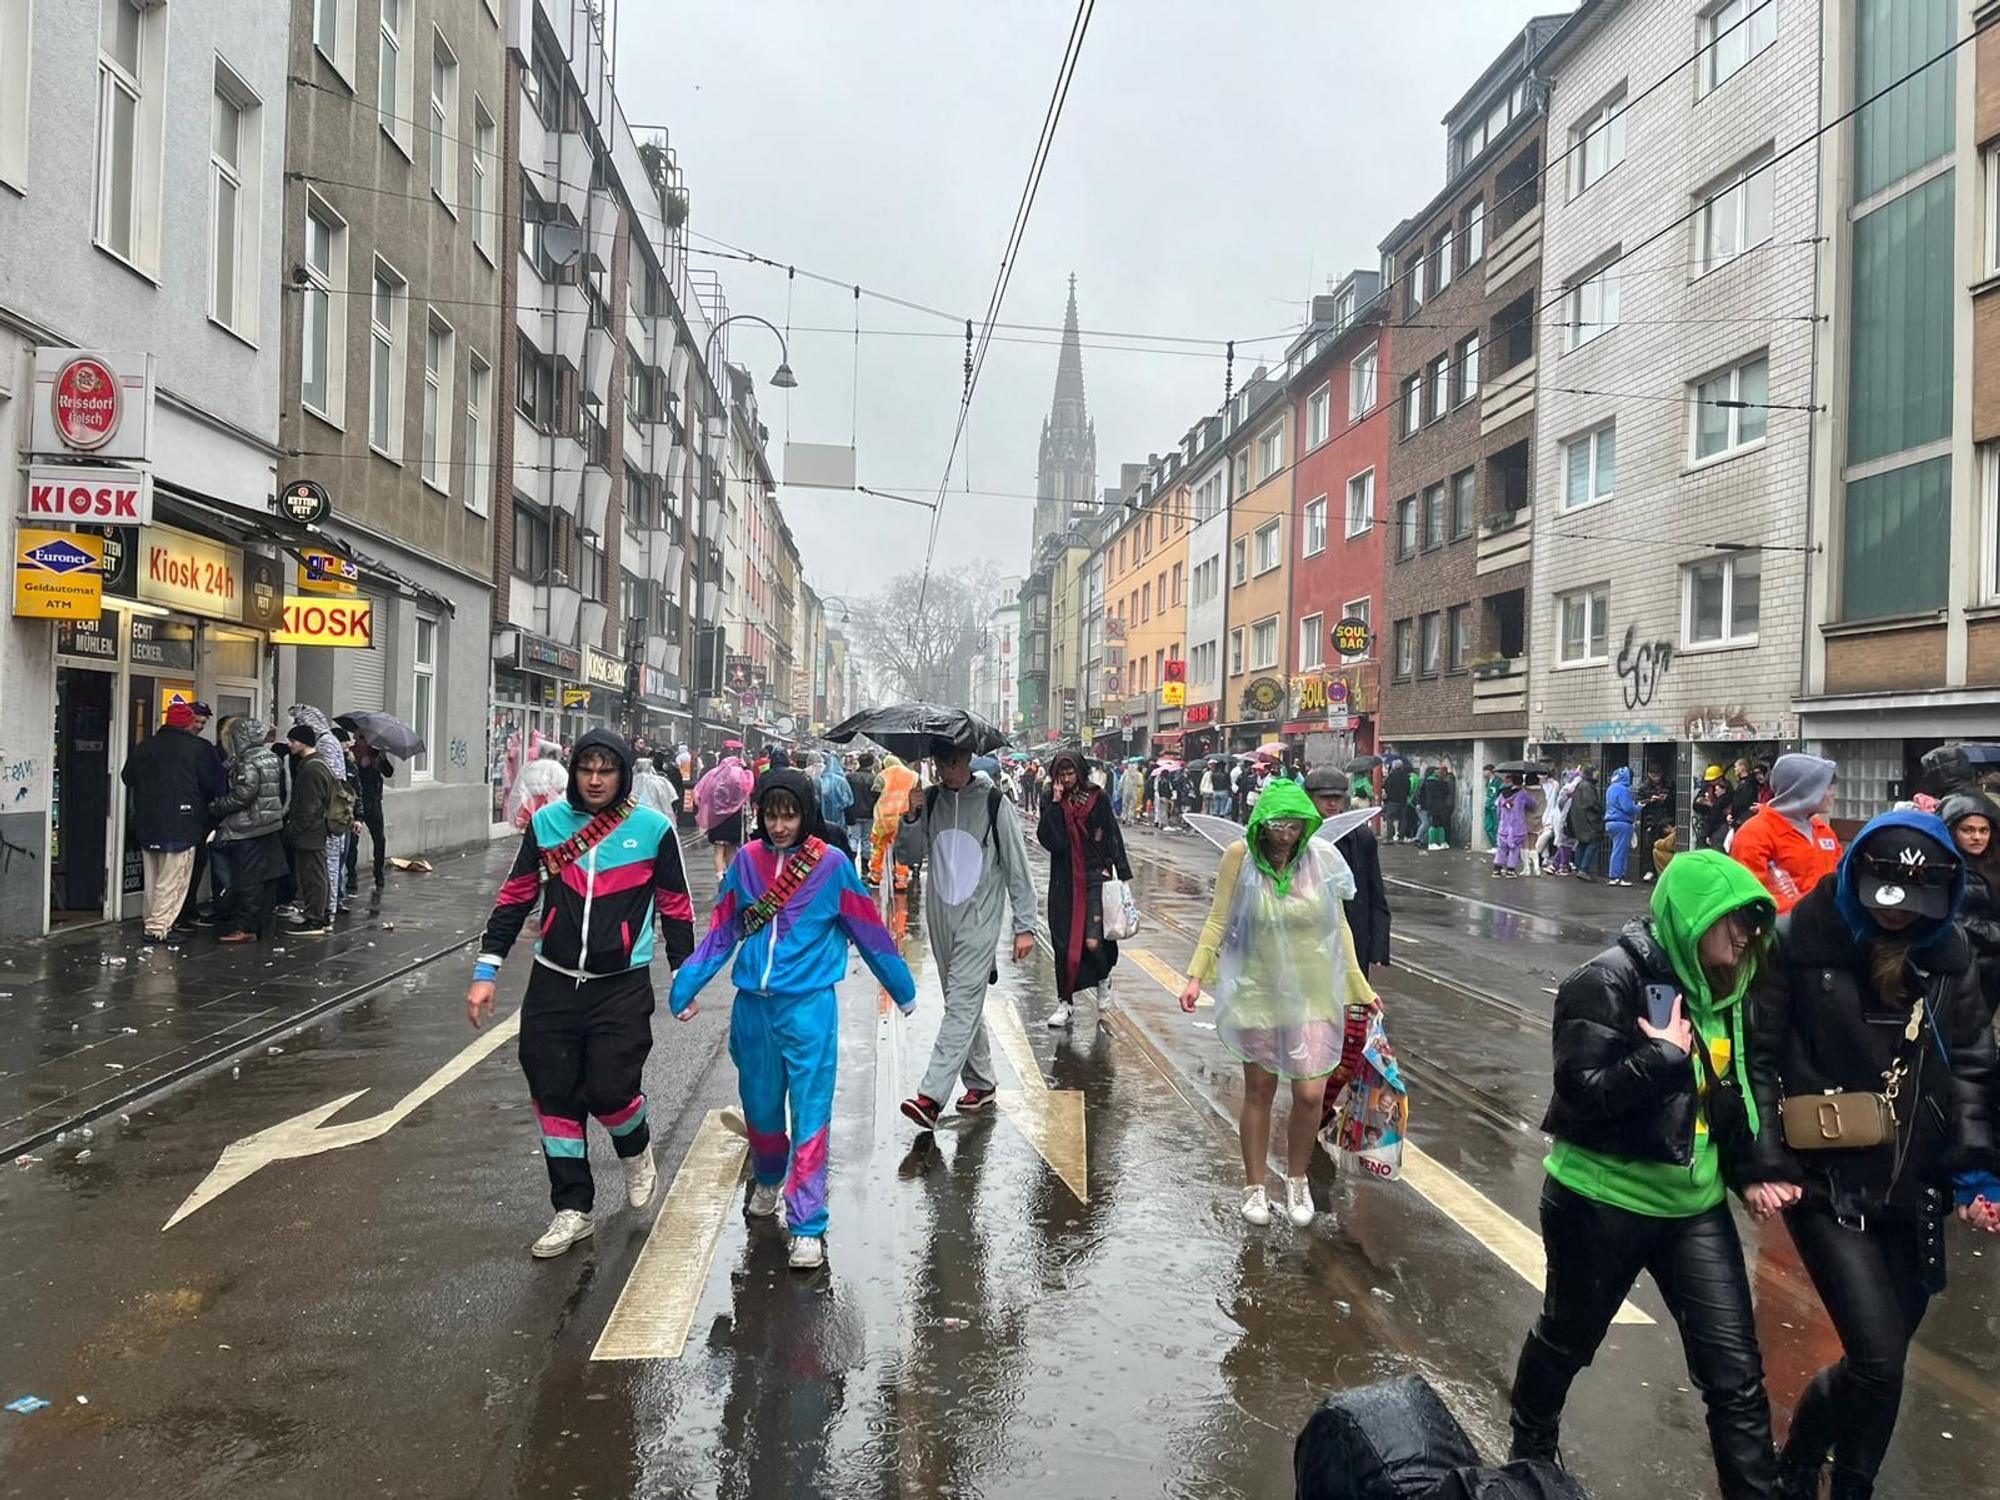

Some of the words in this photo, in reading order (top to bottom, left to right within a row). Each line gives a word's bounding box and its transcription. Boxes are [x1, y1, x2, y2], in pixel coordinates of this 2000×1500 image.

[59, 394, 113, 410] Reissdorf
[31, 485, 138, 517] KIOSK
[287, 496, 318, 508] KETTEN
[292, 507, 312, 516] FETT
[35, 549, 87, 565] Euronet
[103, 555, 117, 572] ETT
[149, 546, 200, 591] Kiosk
[205, 562, 234, 600] 24h
[24, 582, 95, 596] Geldautomat
[46, 600, 72, 609] ATM
[132, 621, 153, 640] ECHT
[1336, 626, 1368, 638] SOUL
[1340, 637, 1365, 649] BAR
[1301, 681, 1325, 710] SOUL
